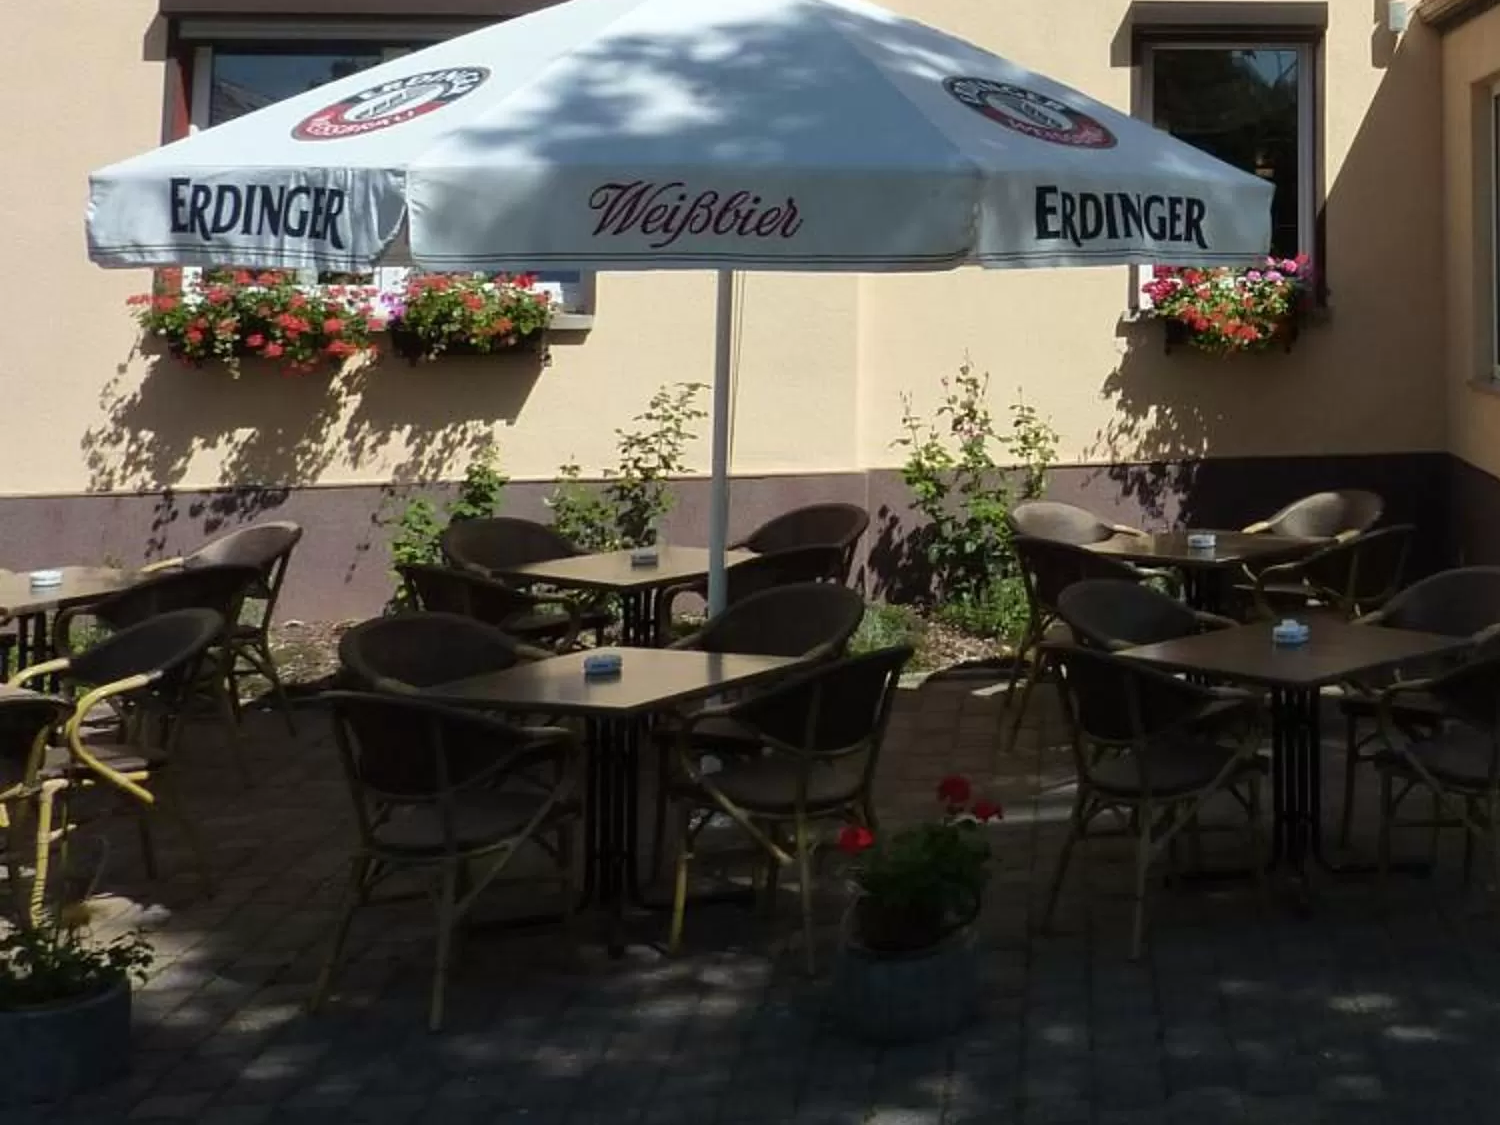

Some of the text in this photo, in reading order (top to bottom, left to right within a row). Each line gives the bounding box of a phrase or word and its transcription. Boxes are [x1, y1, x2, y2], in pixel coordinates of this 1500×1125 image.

[168, 177, 345, 250] ERDINGER
[588, 179, 804, 249] Weißbier
[1035, 185, 1208, 249] ERDINGER
